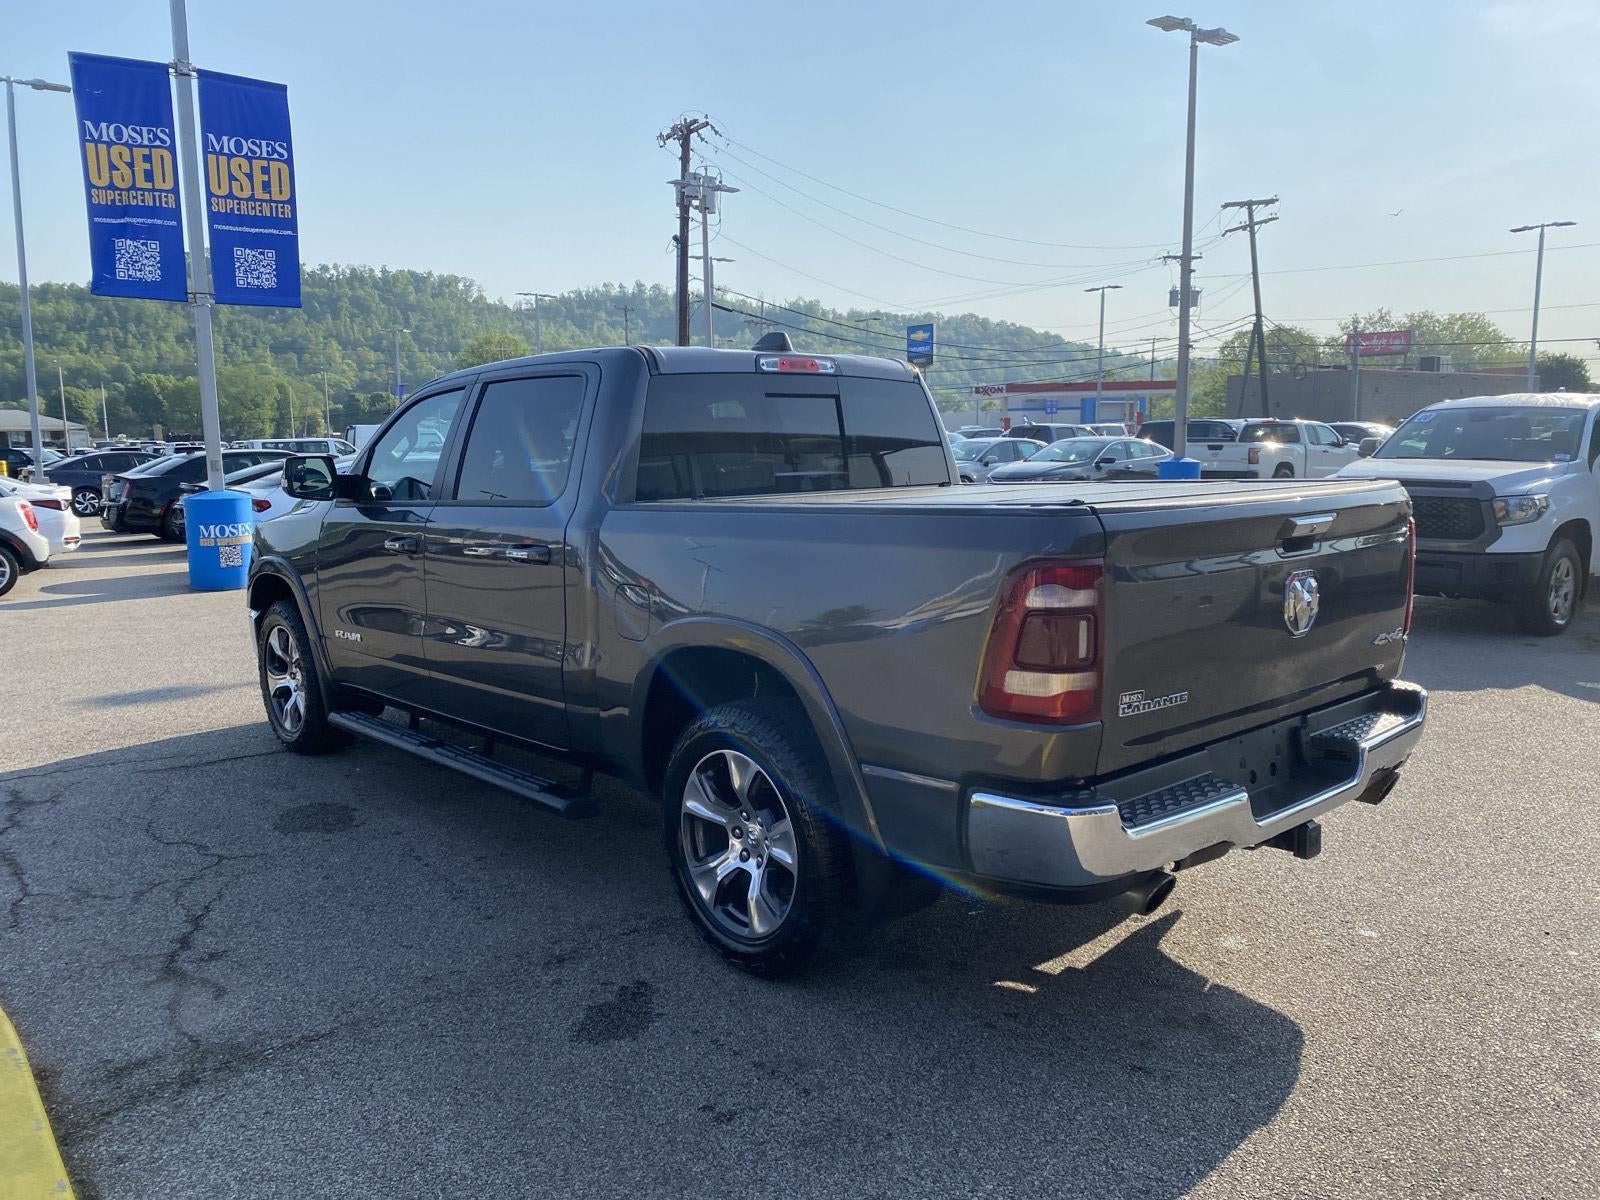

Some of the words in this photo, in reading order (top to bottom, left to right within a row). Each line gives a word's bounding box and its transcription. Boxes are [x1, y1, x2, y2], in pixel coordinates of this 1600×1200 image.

[83, 120, 171, 147] MOSES
[207, 133, 289, 160] MOSES
[84, 142, 175, 191] USED
[207, 153, 291, 201] USED
[91, 188, 176, 209] SUPERCENTER
[211, 197, 292, 219] SUPERCENTER
[974, 385, 1004, 397] EXXON
[198, 522, 253, 539] MOSES
[334, 629, 362, 642] RAM
[1120, 694, 1188, 715] LARAMIE
